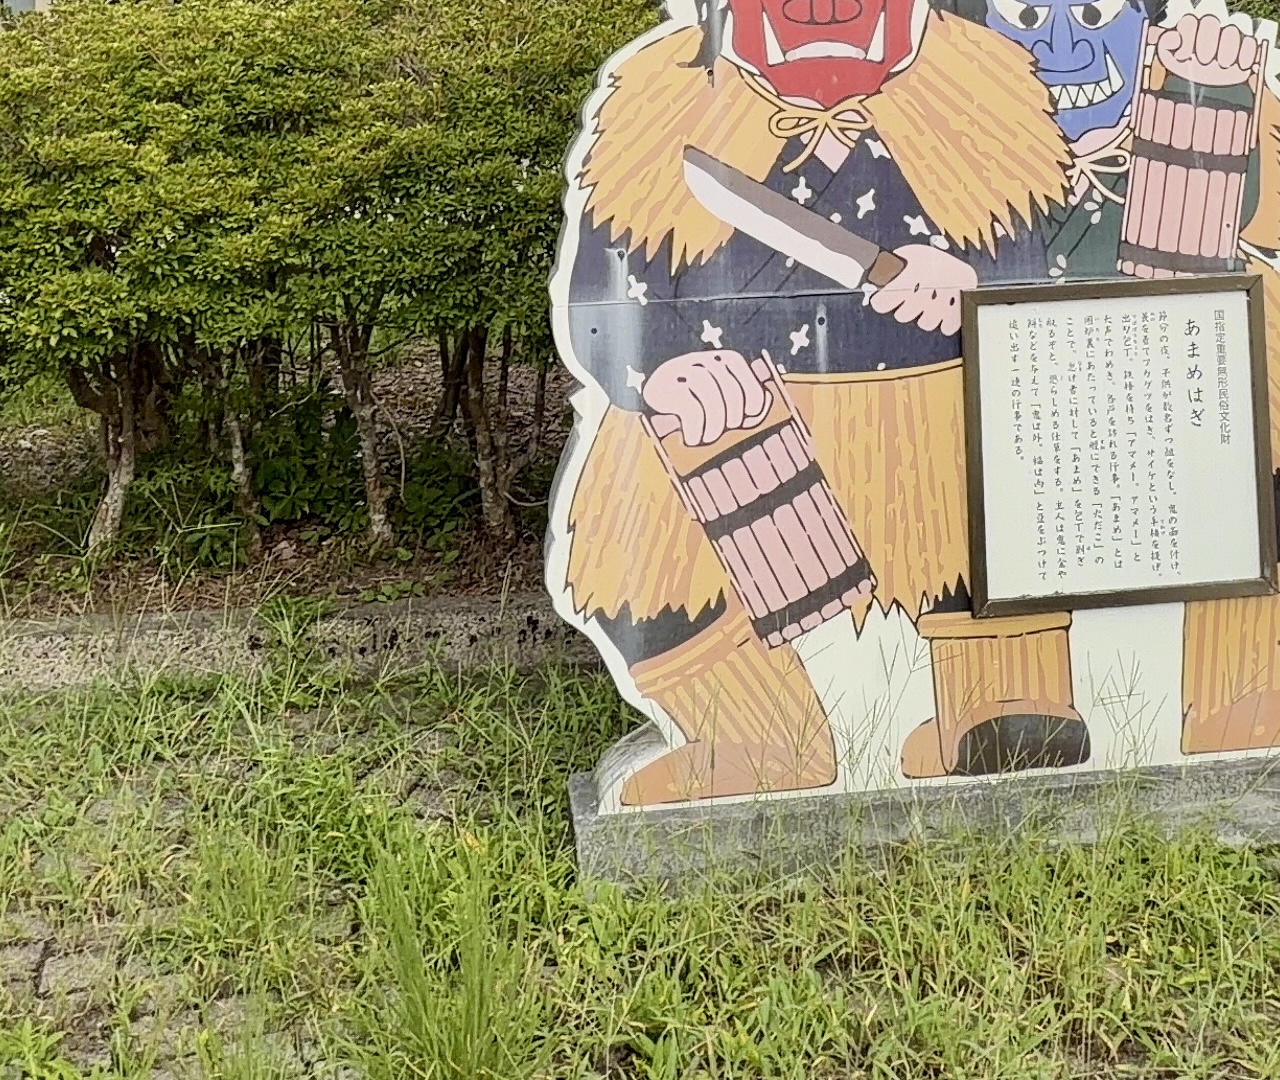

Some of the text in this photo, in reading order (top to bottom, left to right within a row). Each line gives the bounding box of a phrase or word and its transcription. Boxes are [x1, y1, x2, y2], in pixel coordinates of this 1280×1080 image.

[1184, 318, 1205, 427] あまめはぎ
[1214, 309, 1231, 445] 国指定重要無形民俗文化財
